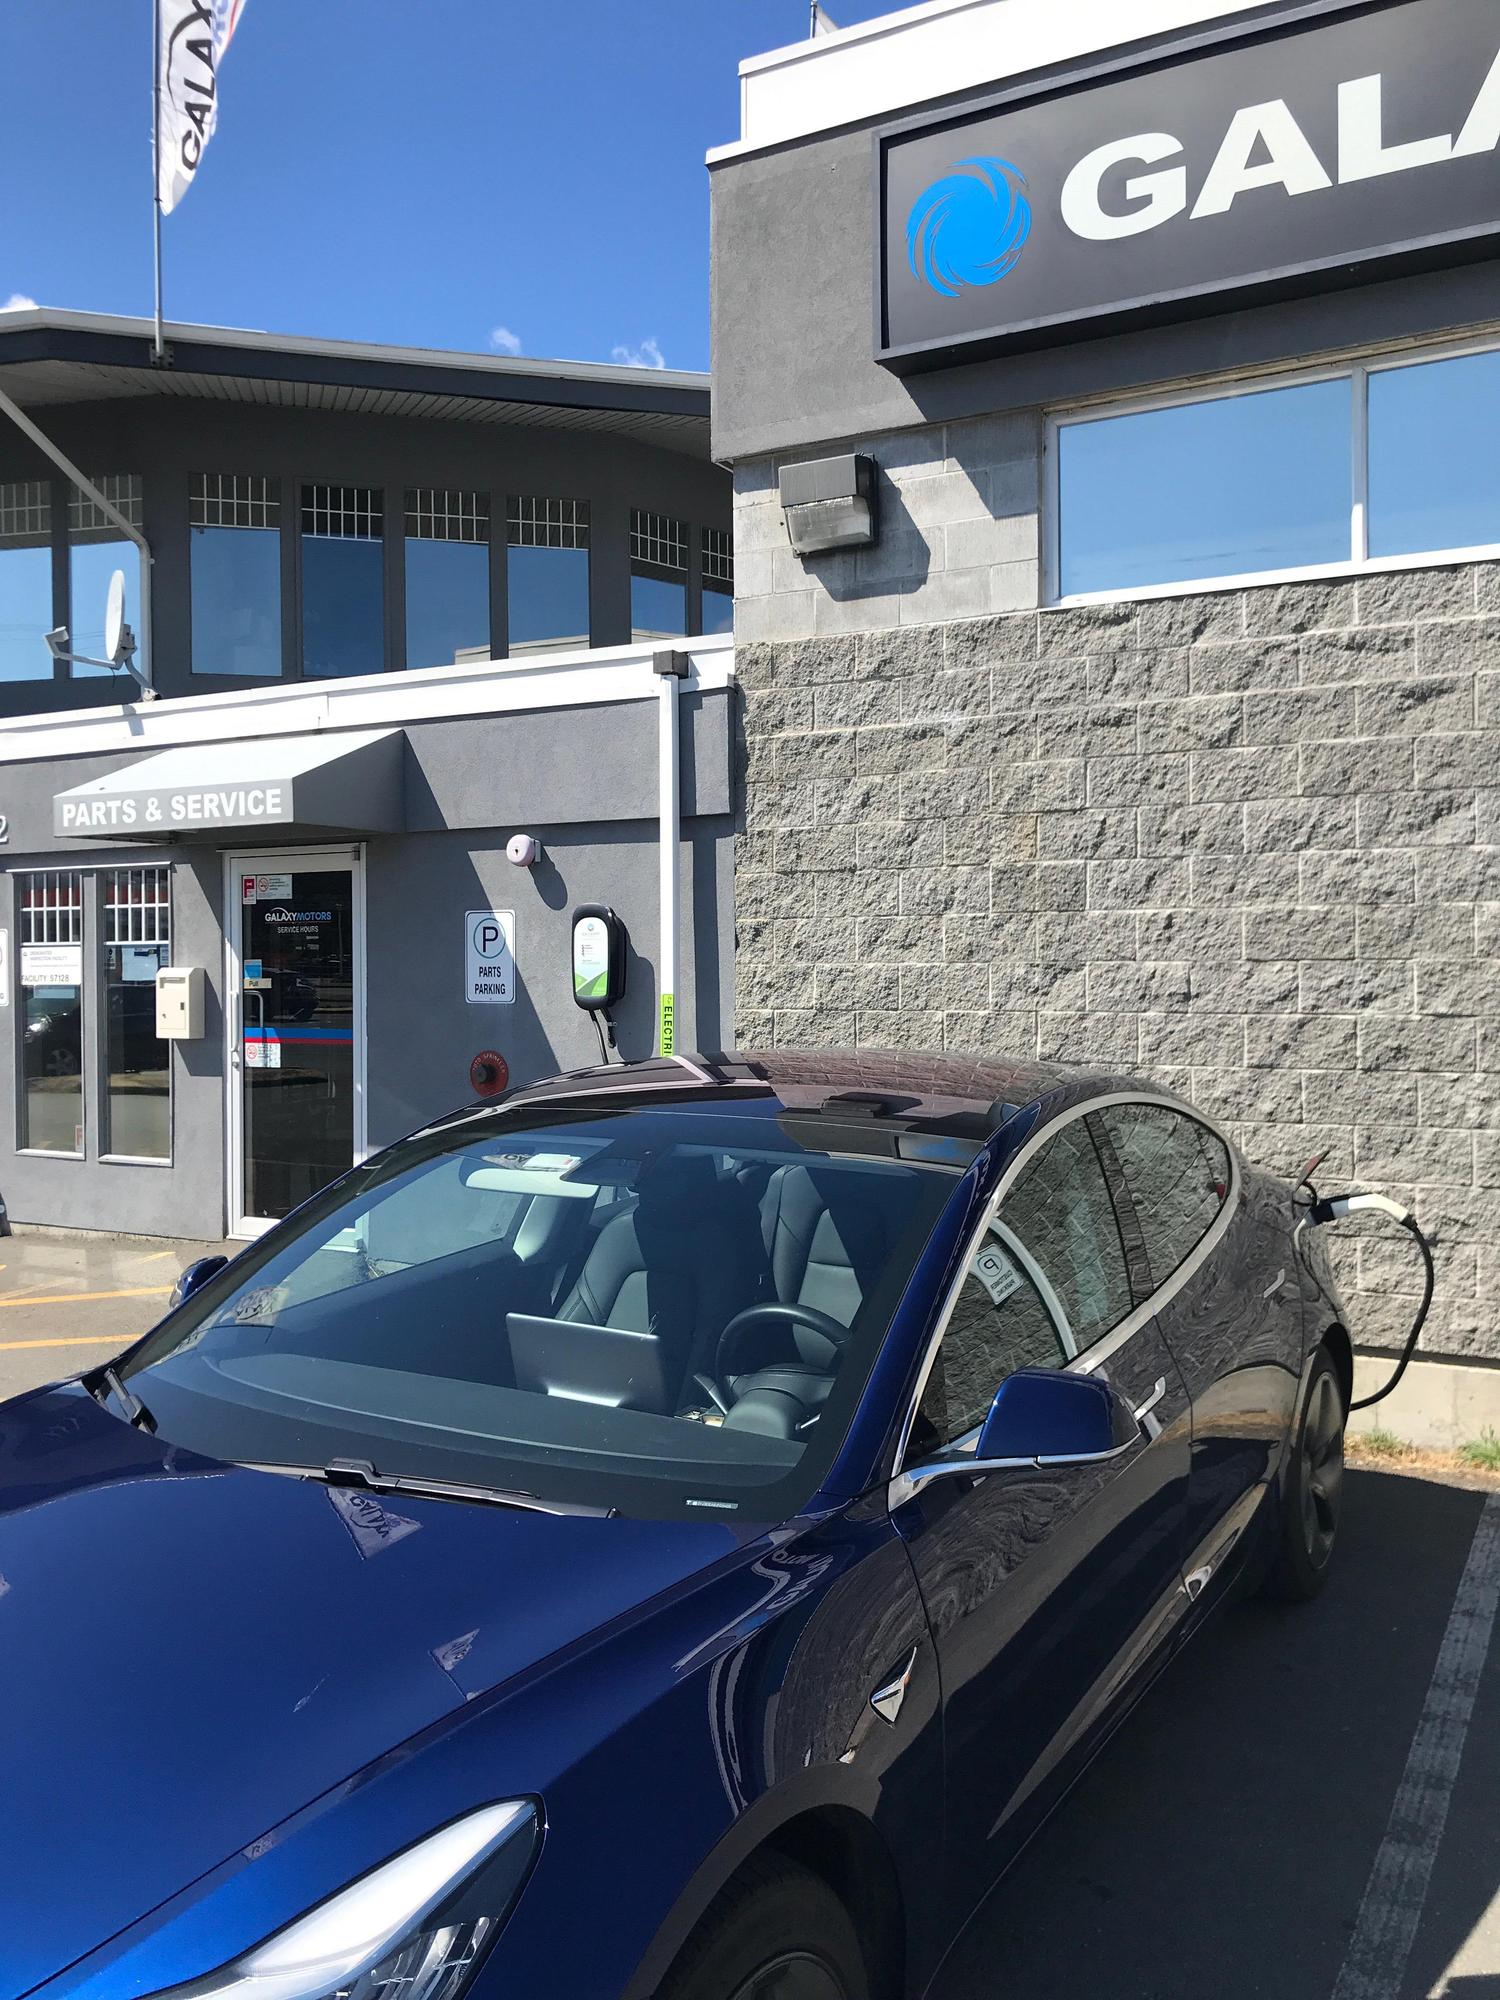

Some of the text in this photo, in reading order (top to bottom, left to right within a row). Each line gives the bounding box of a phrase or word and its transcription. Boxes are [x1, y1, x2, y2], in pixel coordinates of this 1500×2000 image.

[62, 788, 282, 827] PARTS & SERVICE
[483, 926, 498, 952] P
[479, 966, 501, 978] PARTS
[475, 983, 505, 995] PARKING
[664, 1006, 672, 1057] ELECTRI
